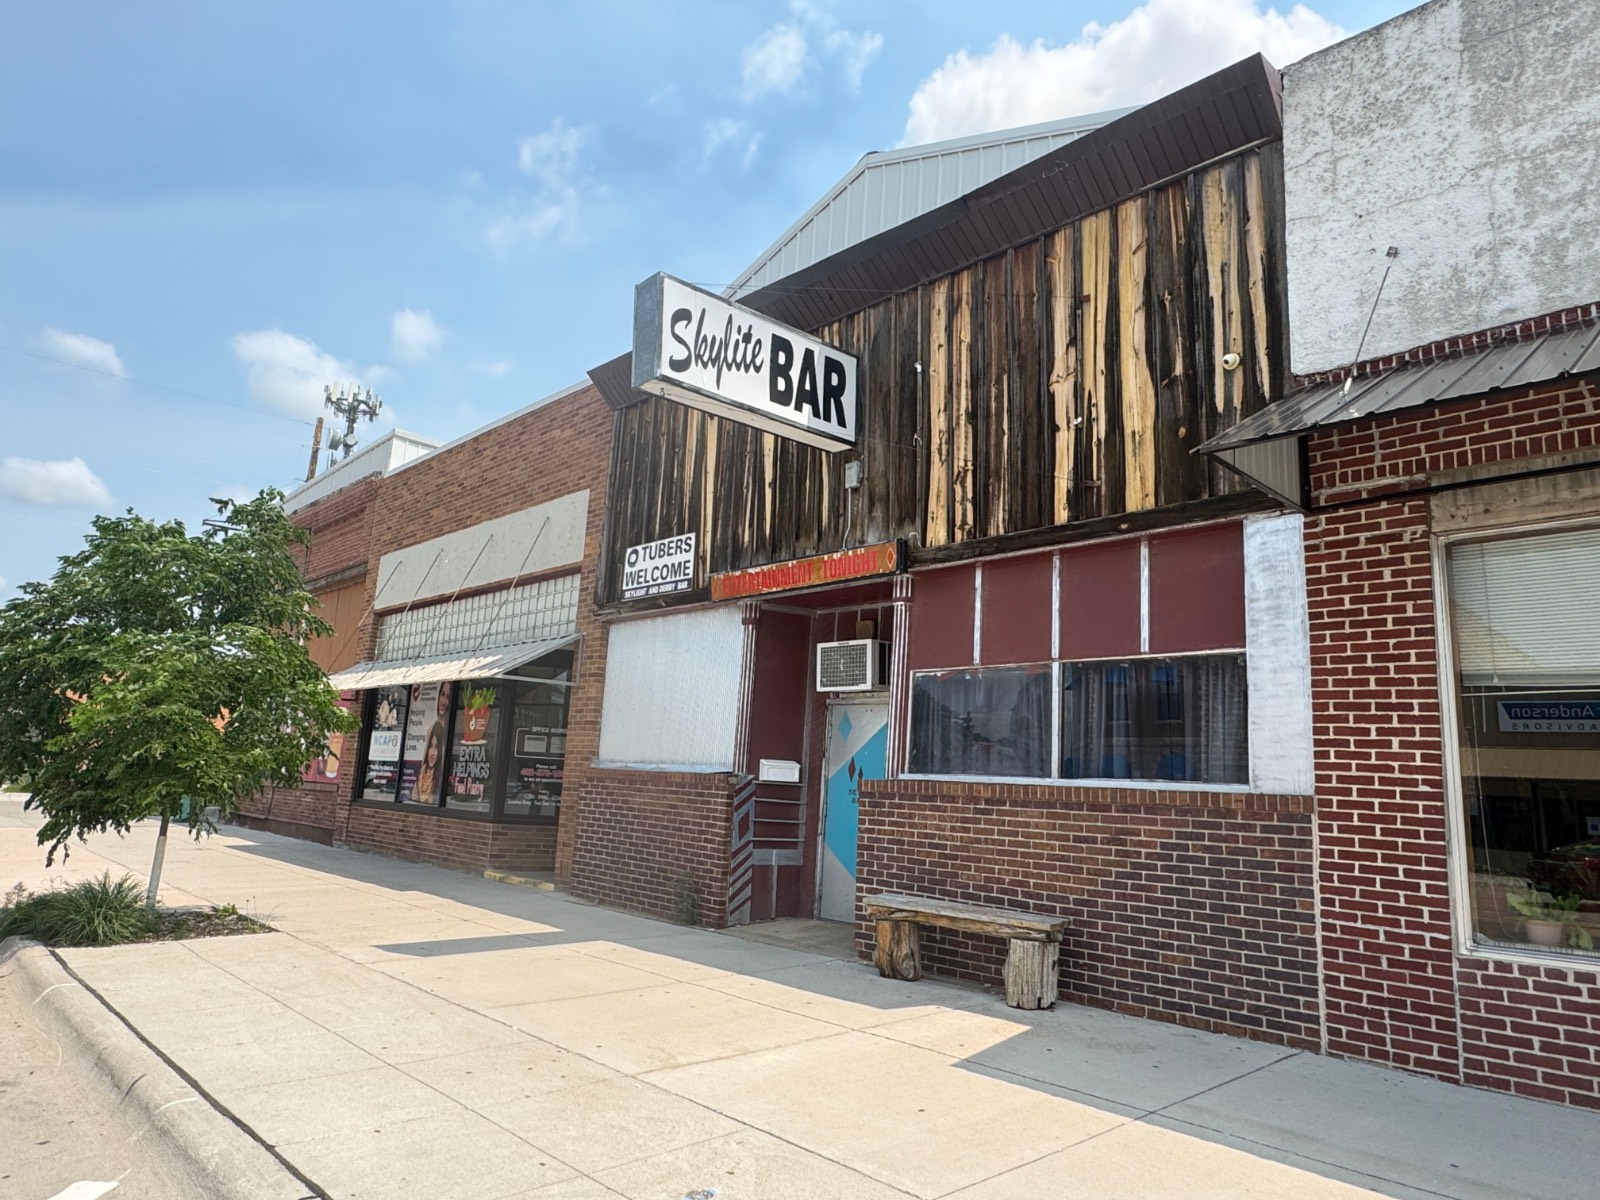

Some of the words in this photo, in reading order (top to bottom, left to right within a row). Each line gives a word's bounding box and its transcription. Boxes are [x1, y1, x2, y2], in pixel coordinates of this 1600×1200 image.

[668, 307, 764, 391] Skylite
[769, 333, 847, 429] BAR
[642, 536, 692, 562] TUBERS
[625, 560, 691, 587] WELCOME
[722, 561, 813, 596] ENTERTAINMENT
[822, 550, 878, 580] TONIGHT
[624, 588, 647, 599] SKYLIGHT
[648, 586, 659, 595] AND
[677, 580, 688, 590] BAR
[459, 745, 486, 762] EXTRA
[453, 761, 490, 779] HELPINGS
